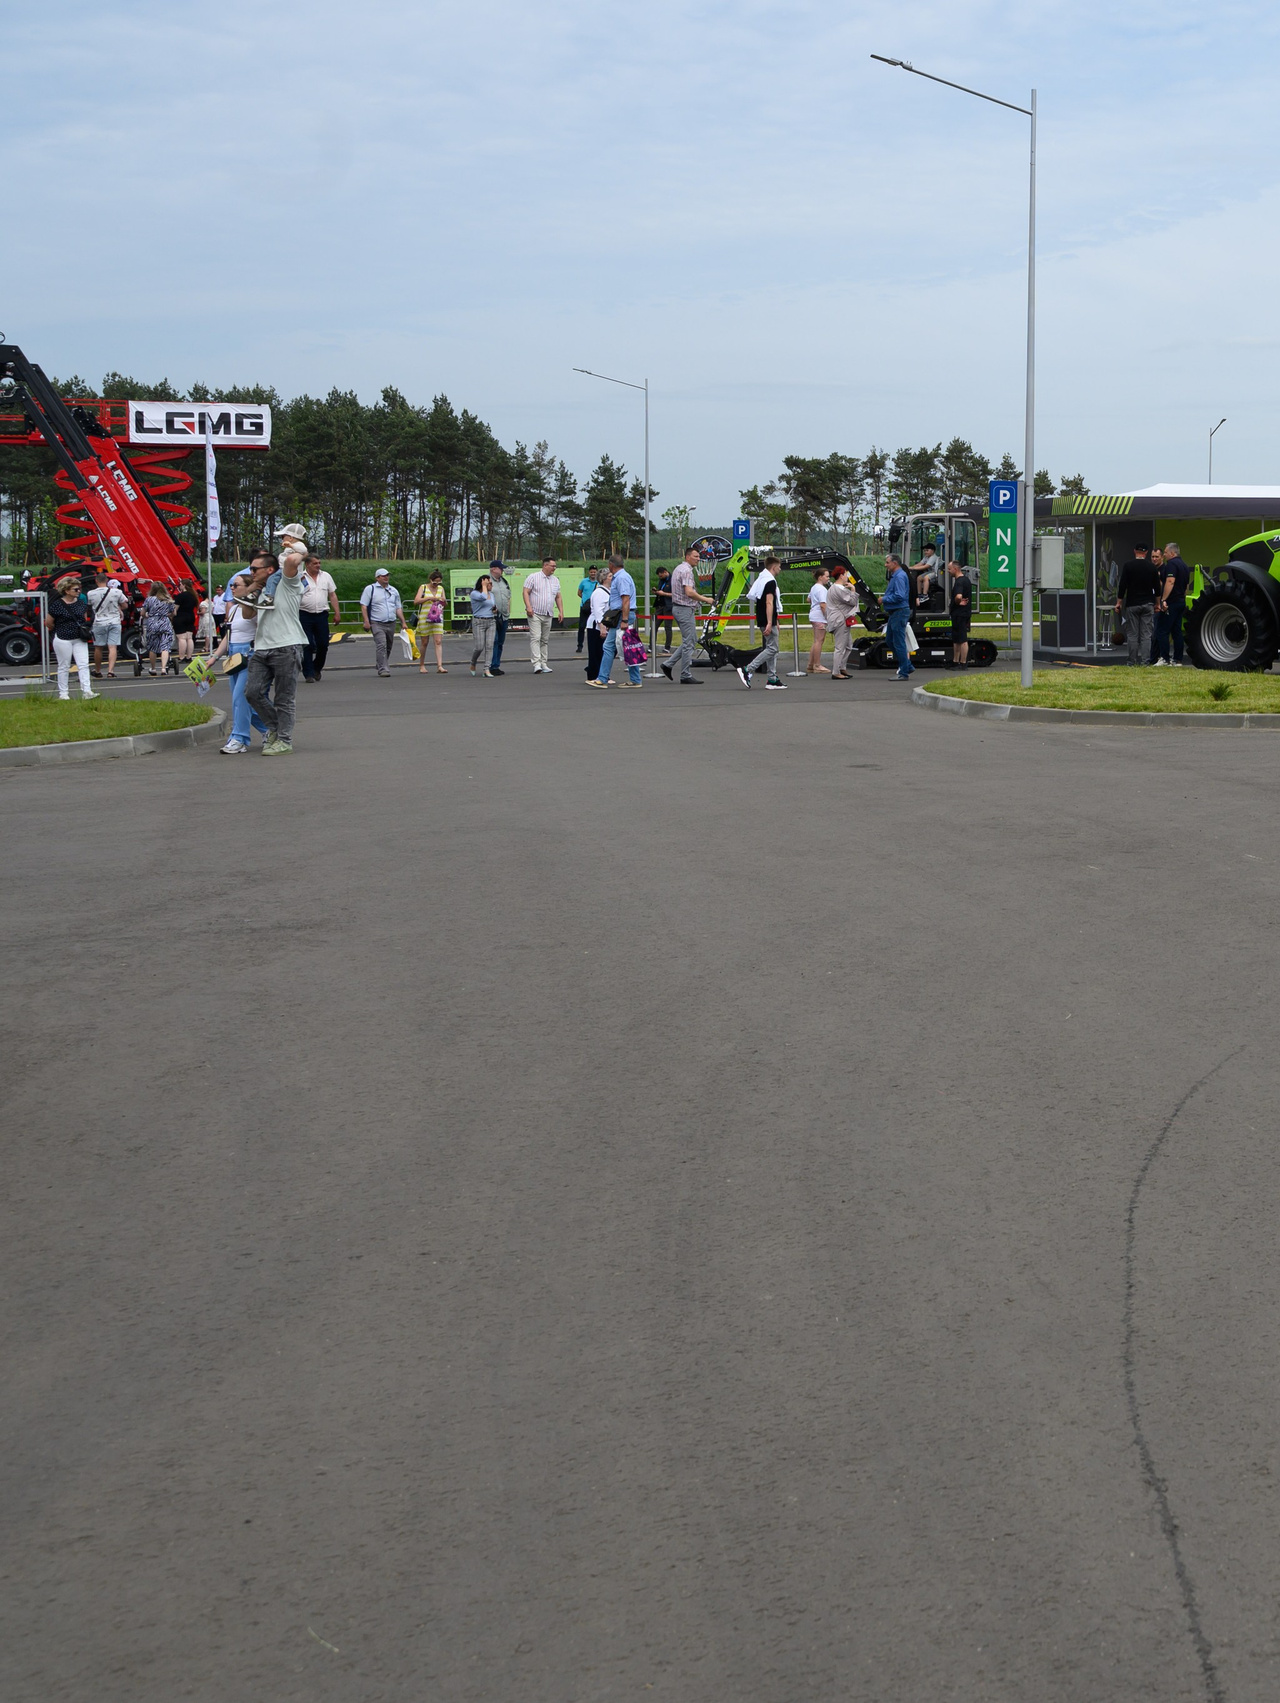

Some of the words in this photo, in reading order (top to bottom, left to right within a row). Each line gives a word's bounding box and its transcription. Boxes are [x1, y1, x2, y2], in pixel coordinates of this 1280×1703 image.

[135, 411, 264, 436] LGMG
[106, 460, 138, 502] LGMG
[97, 485, 117, 512] LGMG
[999, 490, 1010, 504] P
[738, 525, 746, 535] P
[996, 528, 1011, 546] N
[118, 546, 139, 574] LGMG
[790, 561, 821, 569] ZOOMLION
[997, 555, 1009, 573] 2
